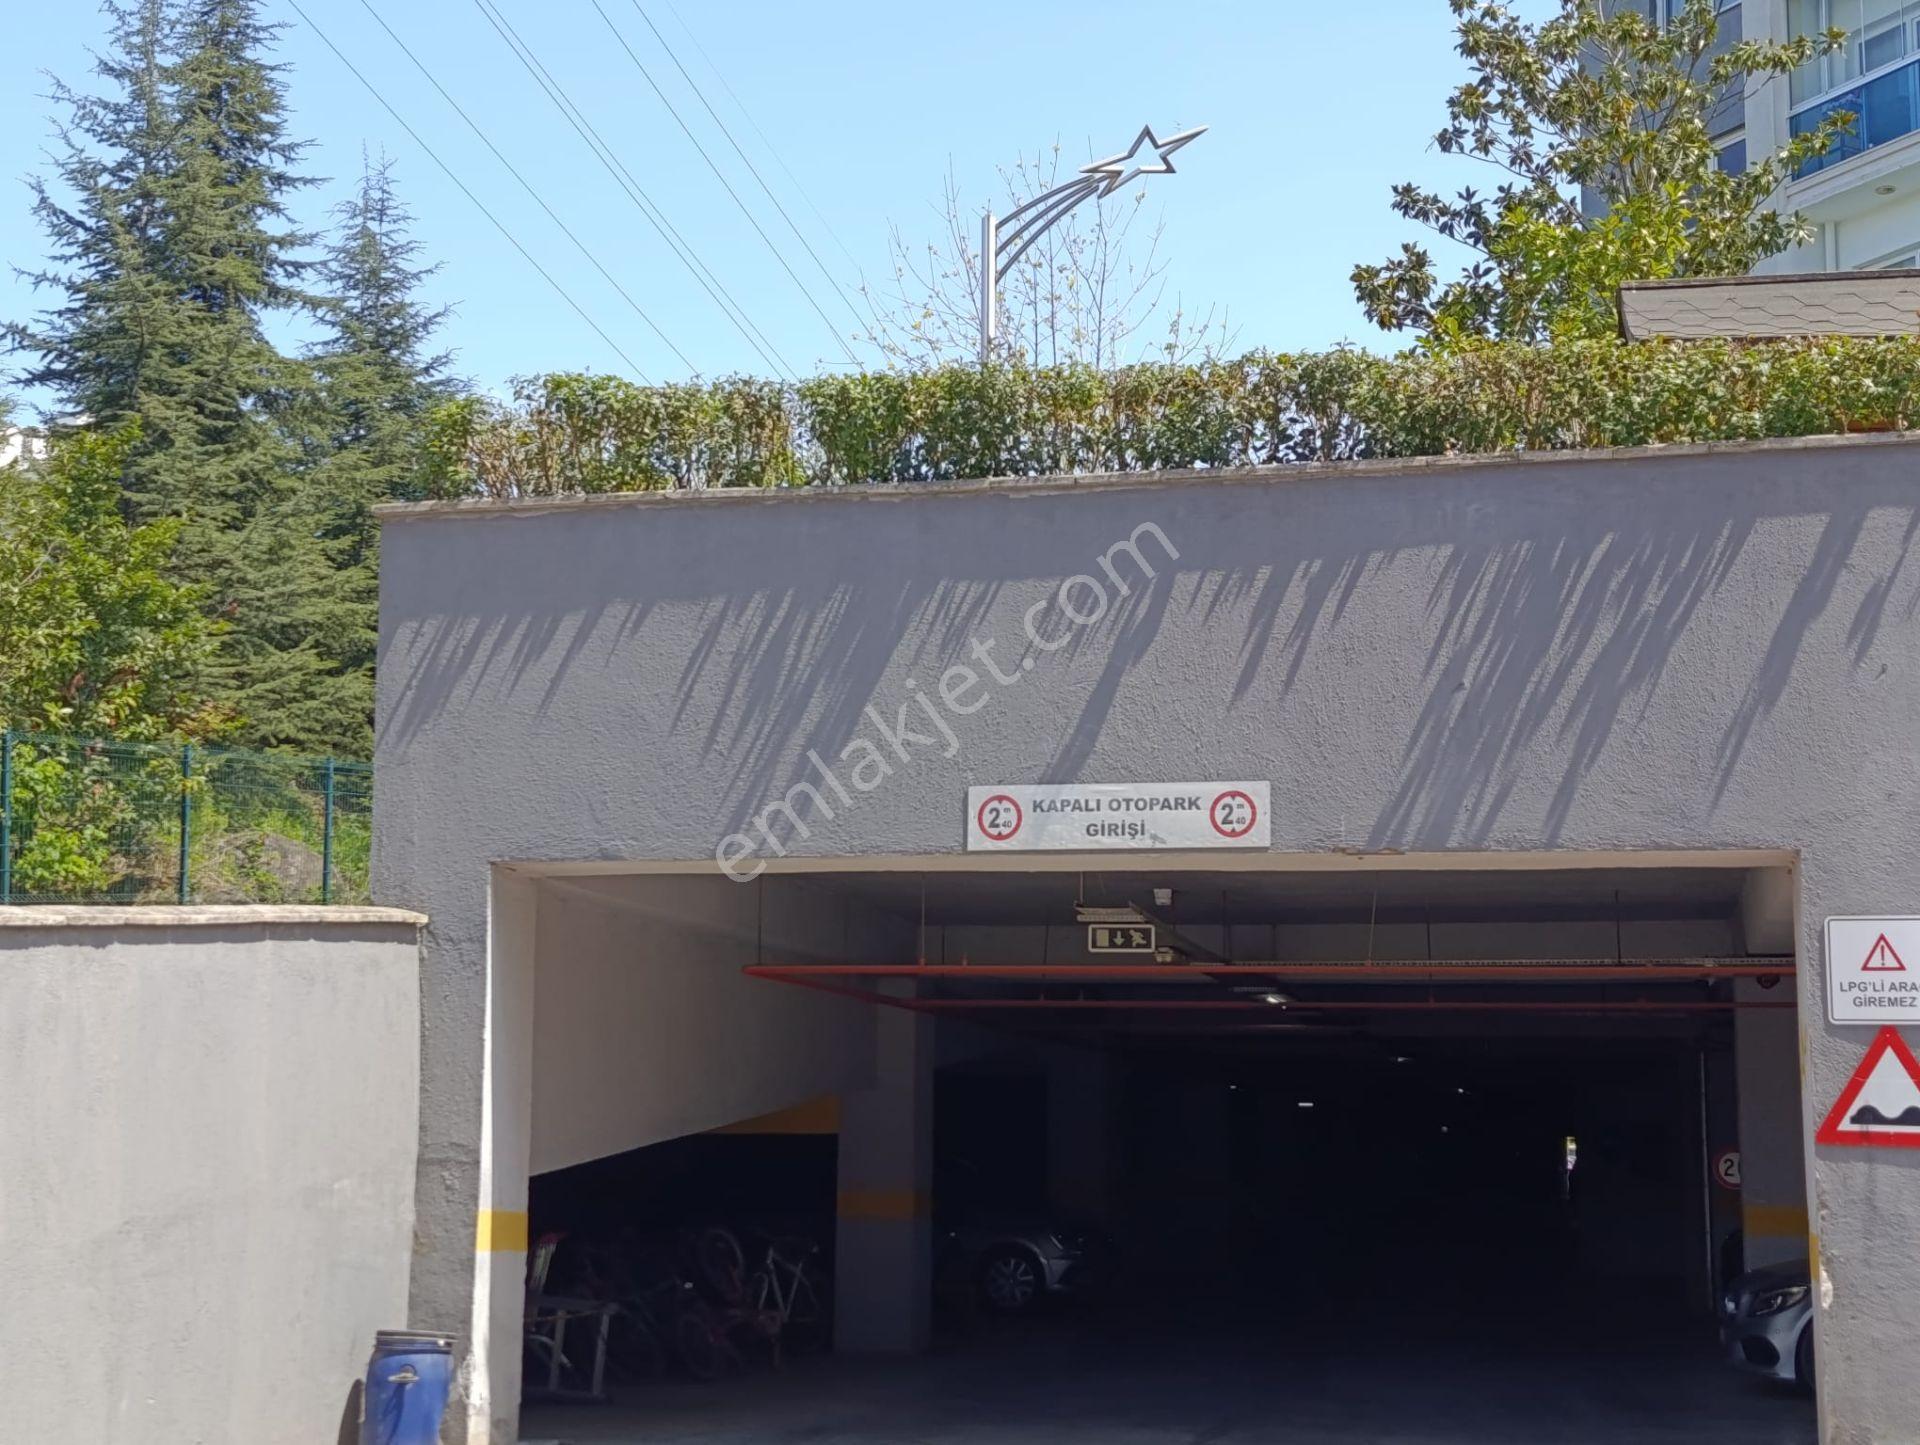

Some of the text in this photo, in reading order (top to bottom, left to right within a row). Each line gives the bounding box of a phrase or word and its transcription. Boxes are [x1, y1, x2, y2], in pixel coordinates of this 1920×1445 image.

[1032, 796, 1202, 813] KAPALI OTOPARK
[988, 807, 1000, 828] 2
[1221, 803, 1234, 825] 2
[1235, 817, 1246, 825] 40
[1002, 820, 1012, 828] 40
[1086, 819, 1146, 840] GİRİŞİ
[1840, 979, 1920, 993] LPG'Lİ ARA
[1852, 994, 1917, 1008] GİREMEZ
[1723, 1158, 1741, 1177] 2
